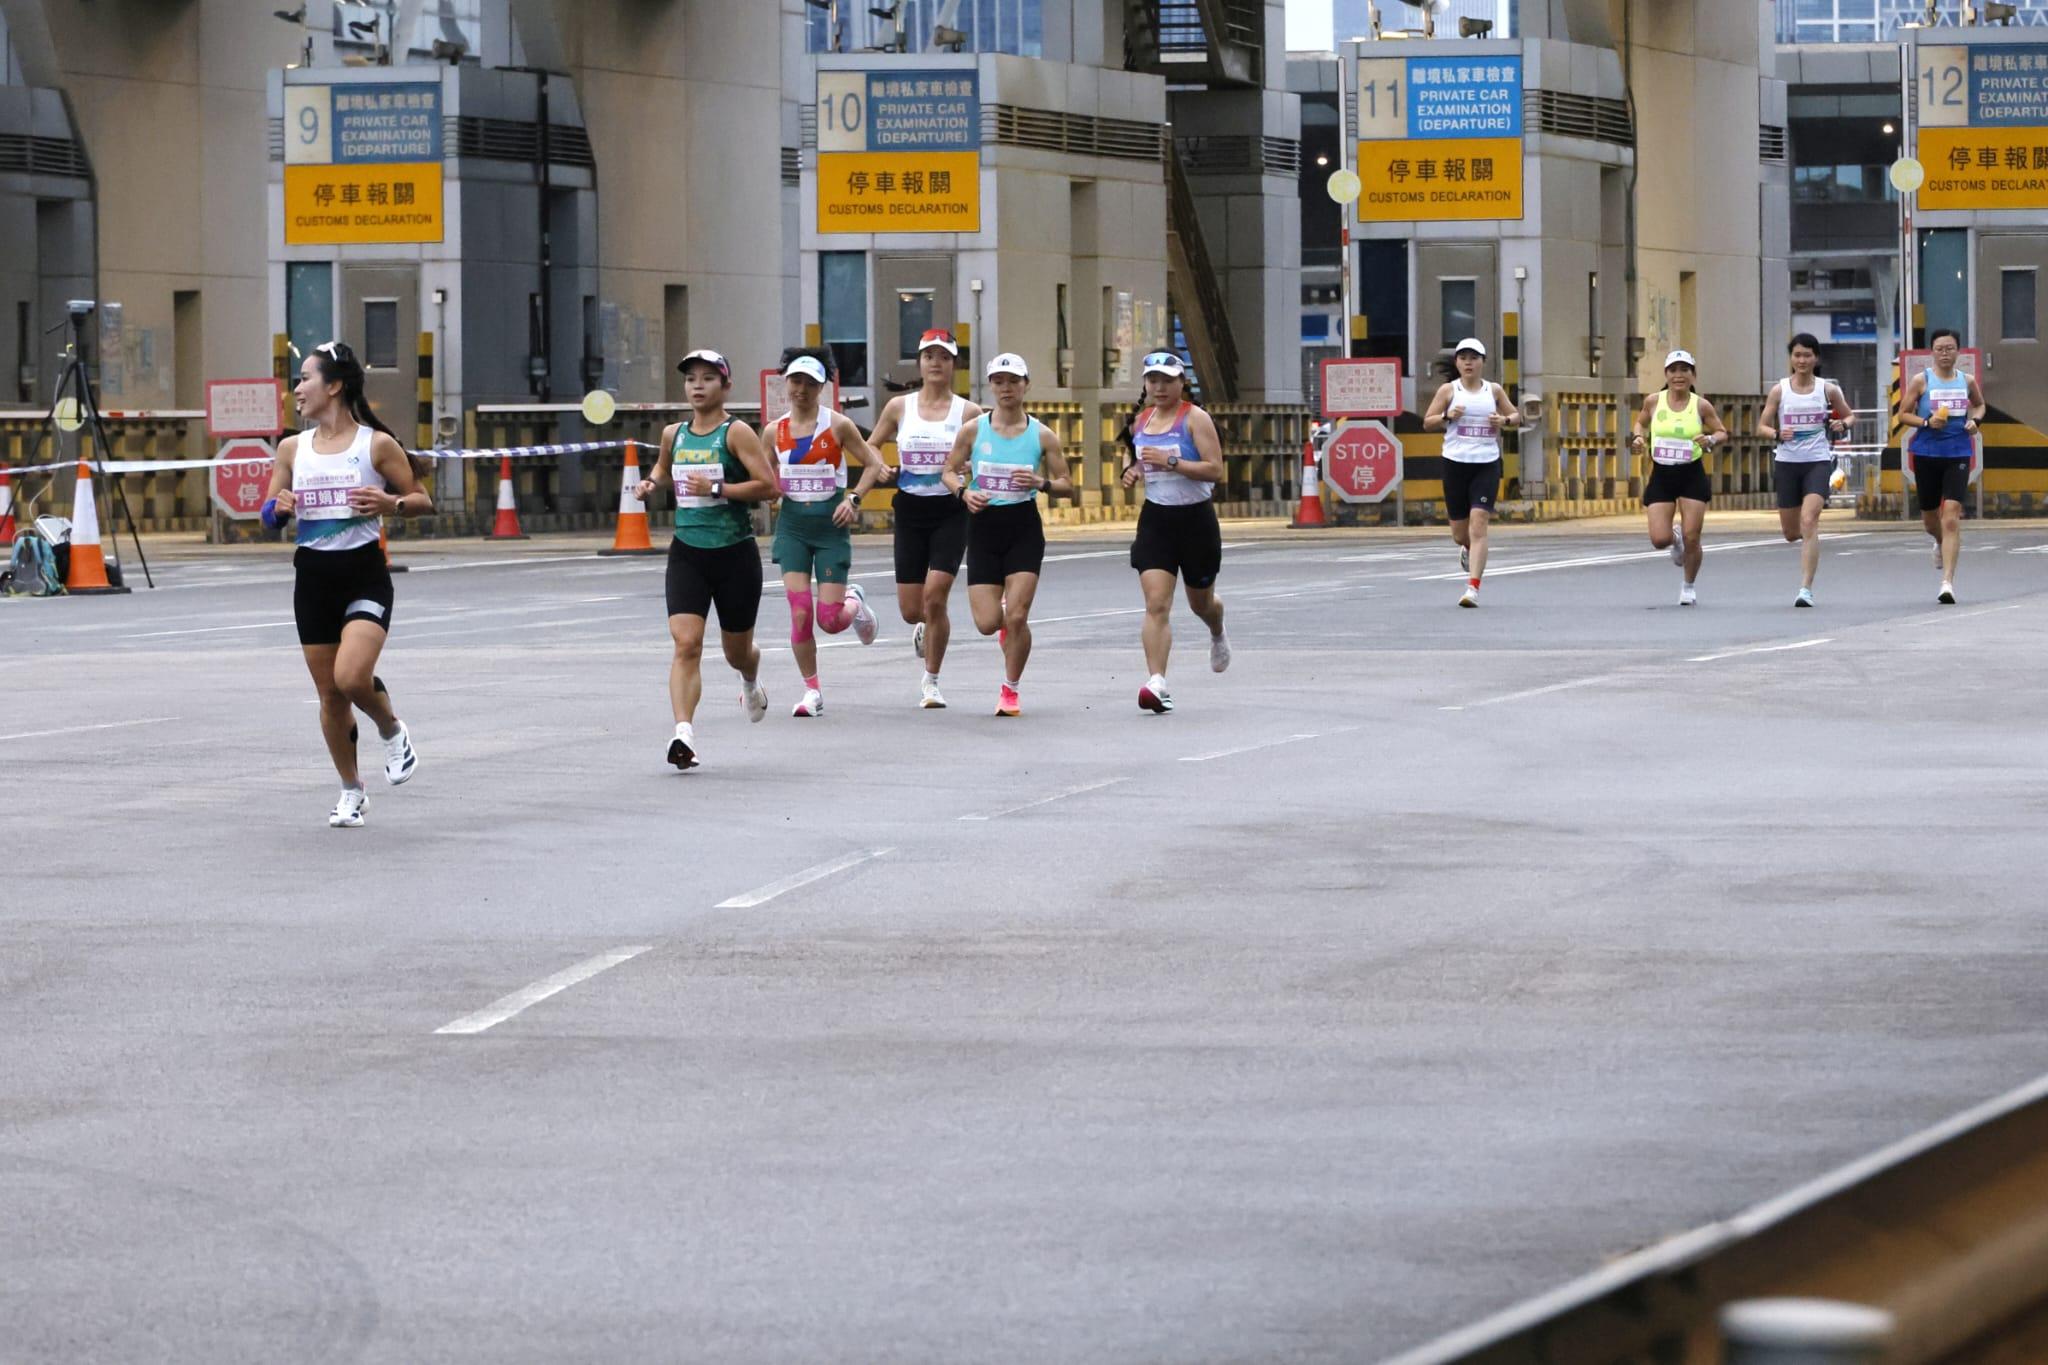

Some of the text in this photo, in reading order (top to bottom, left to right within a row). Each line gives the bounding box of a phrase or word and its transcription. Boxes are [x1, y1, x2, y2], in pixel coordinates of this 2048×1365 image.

[1922, 66, 1963, 106] 12
[1981, 77, 2038, 89] PRIVATE
[1364, 79, 1399, 119] 11
[1420, 89, 1509, 101] PRIVATE CAR
[822, 92, 862, 132] 10
[879, 103, 966, 115] PRIVATE CAR
[1417, 103, 1511, 116] EXAMINATION
[299, 106, 319, 145] 9
[344, 115, 428, 127] PRIVATE CAR
[876, 117, 969, 129] EXAMINATION
[1418, 117, 1511, 132] (DEPARTURE)
[341, 129, 431, 142] EXAMINATION
[877, 131, 968, 145] (DEPARTURE)
[342, 142, 431, 157] (DEPARTURE)
[1387, 157, 1493, 183] 停車報關
[847, 171, 951, 195] 停車報關
[1929, 178, 2048, 191] CUSTOMS DECLARA
[313, 182, 415, 207] 停車報關
[1369, 190, 1511, 203] CUSTOMS DECLARATION
[829, 203, 969, 215] CUSTOMS DECLARATION
[296, 214, 432, 227] CUSTOMS DECLARATION
[1335, 443, 1390, 460] STOP
[222, 462, 273, 478] STOP
[1352, 465, 1376, 490] 停
[238, 483, 260, 507] 停
